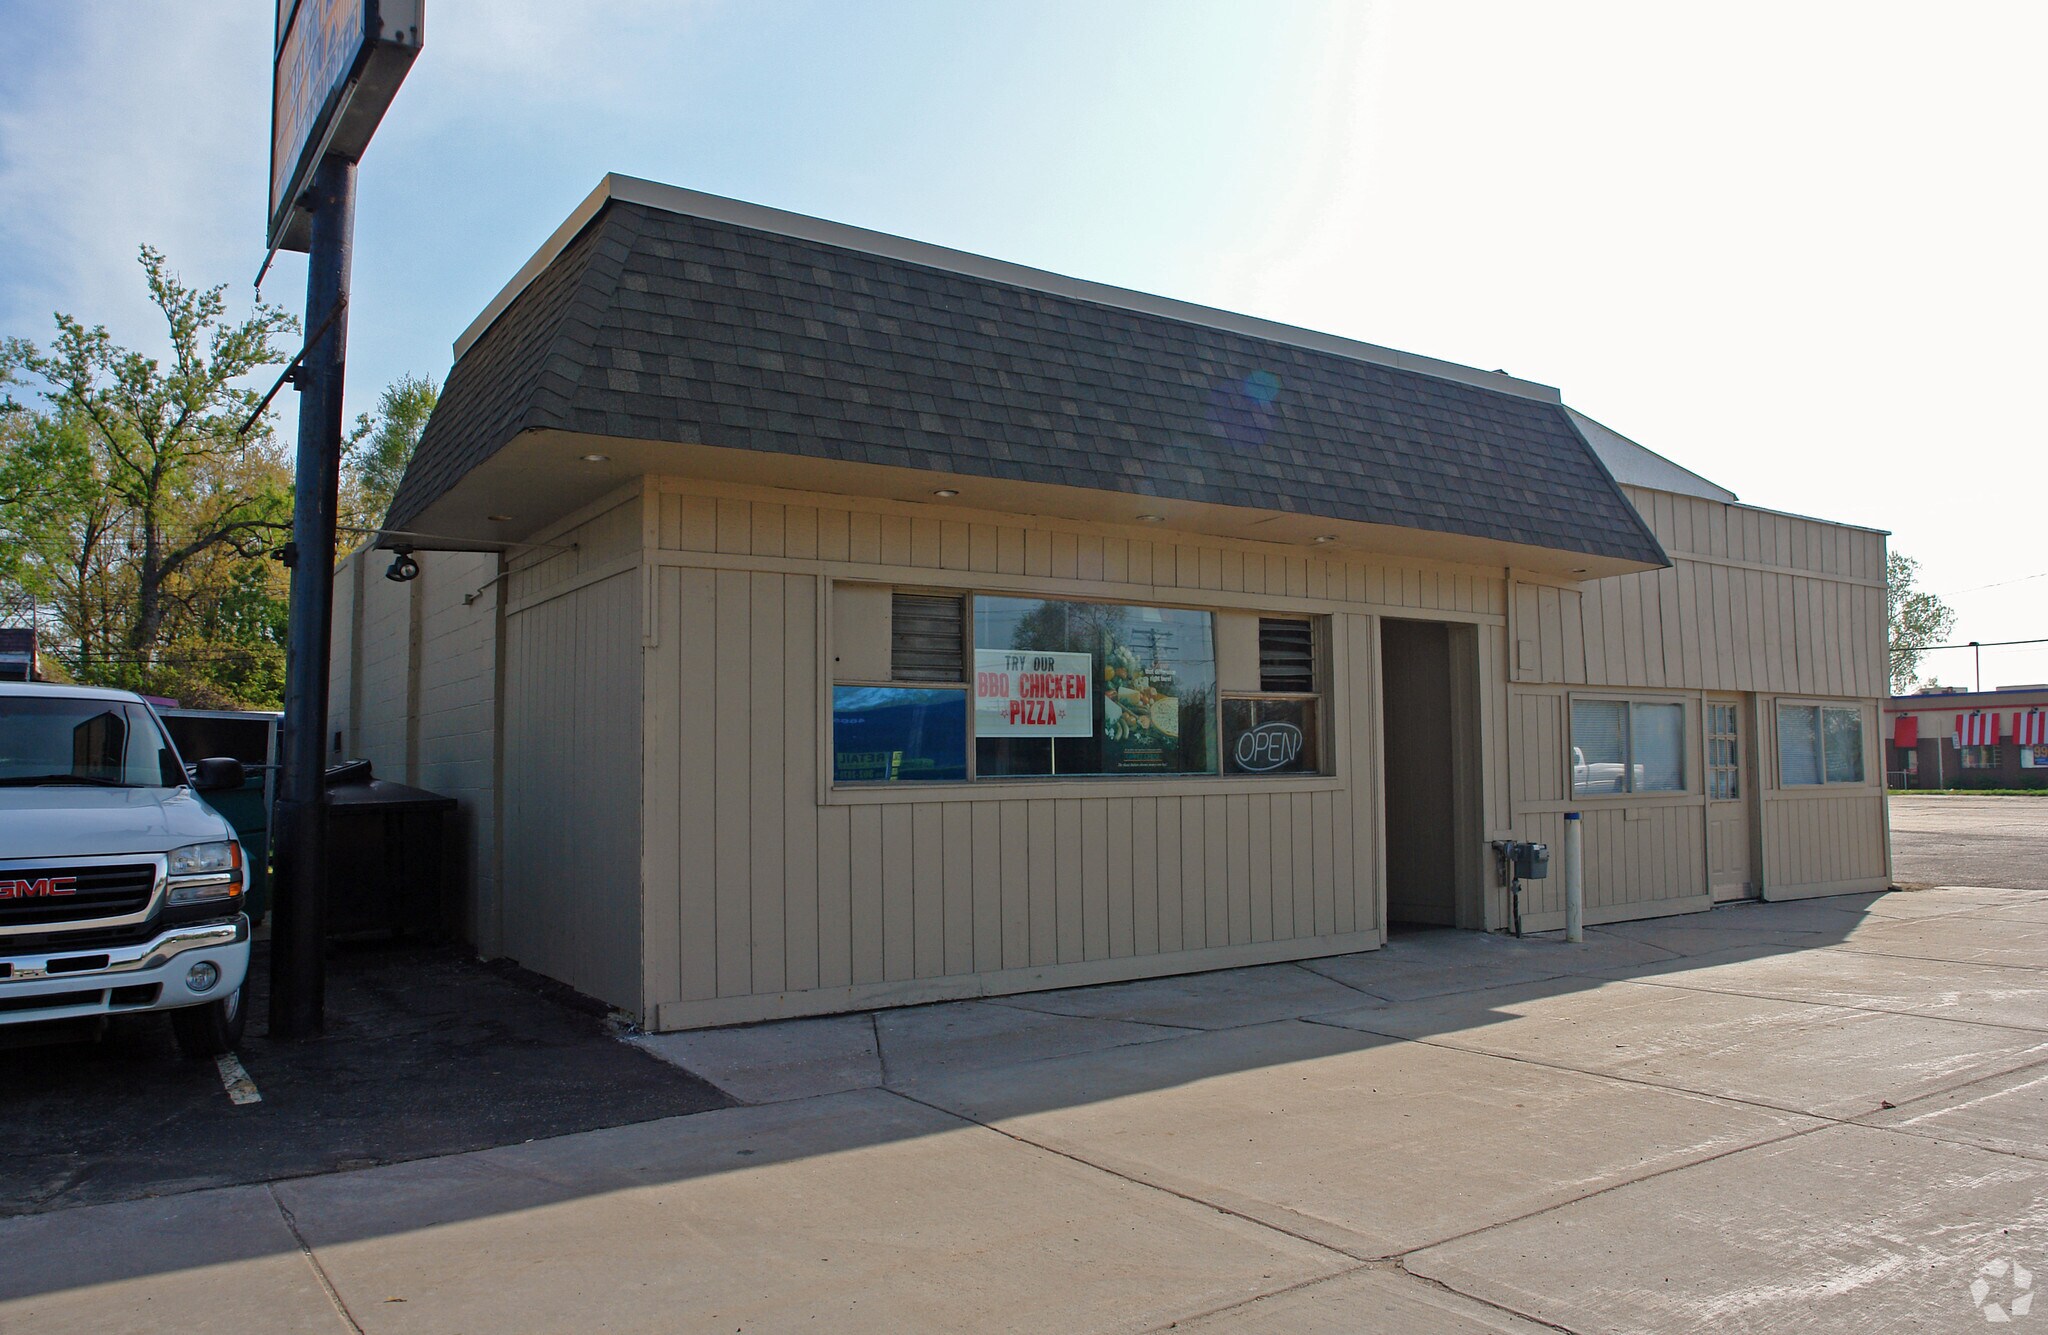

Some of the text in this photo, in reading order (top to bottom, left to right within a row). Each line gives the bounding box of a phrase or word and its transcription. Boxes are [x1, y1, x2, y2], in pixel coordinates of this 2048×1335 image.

[1005, 655, 1055, 671] TRY OUR
[977, 672, 1086, 699] BBQ CHICKEN
[1010, 699, 1057, 725] PIZZA
[1238, 732, 1297, 762] OPEN
